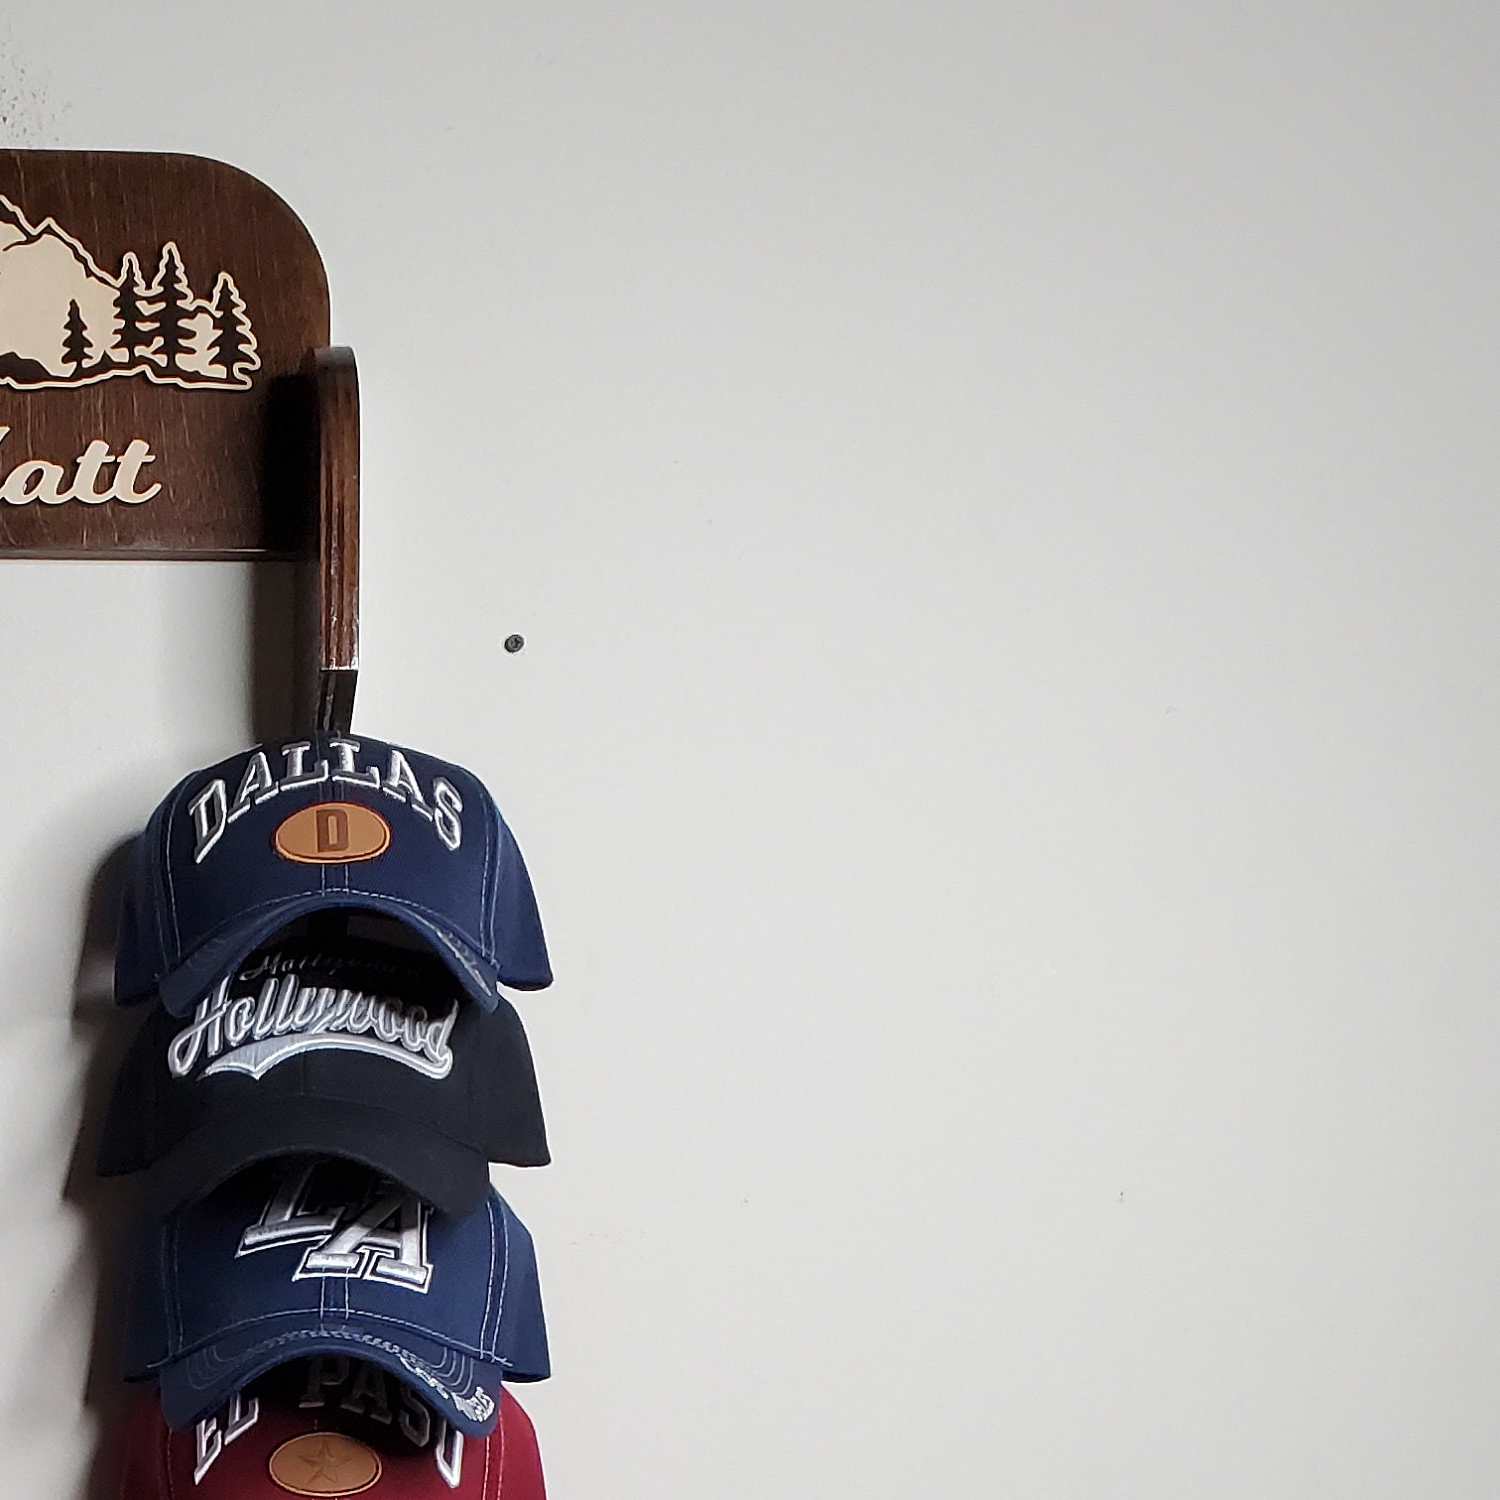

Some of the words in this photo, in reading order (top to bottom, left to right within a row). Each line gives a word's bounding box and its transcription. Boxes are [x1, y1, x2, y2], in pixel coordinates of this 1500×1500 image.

[189, 739, 464, 864] DALLAS
[316, 808, 350, 852] D
[167, 973, 459, 1080] Hollywood
[233, 1163, 436, 1295] LA
